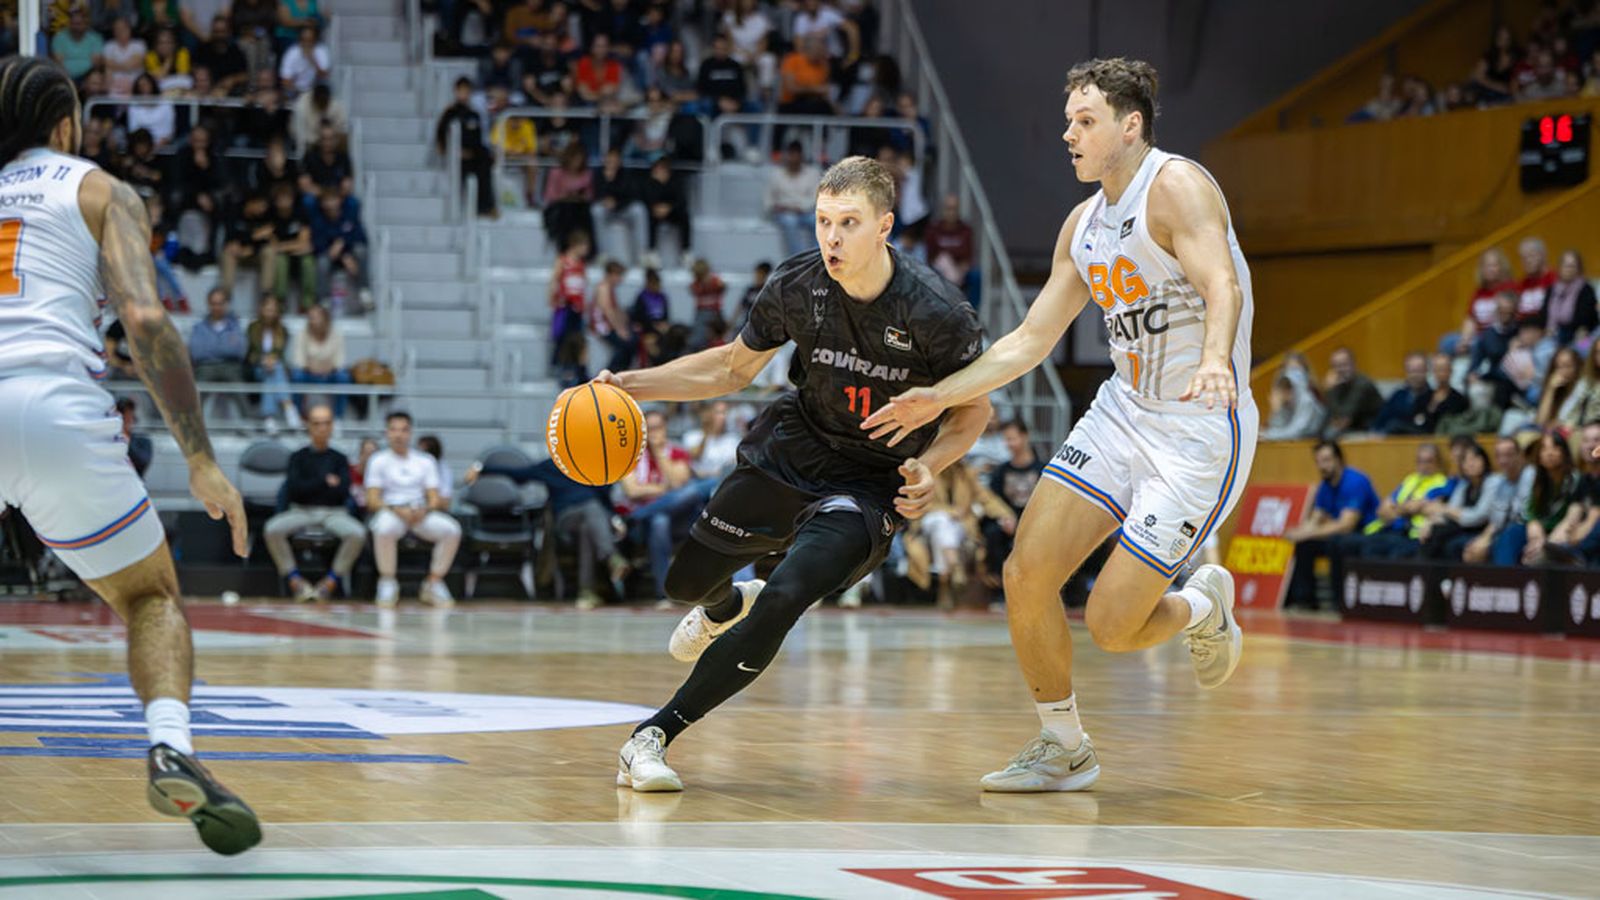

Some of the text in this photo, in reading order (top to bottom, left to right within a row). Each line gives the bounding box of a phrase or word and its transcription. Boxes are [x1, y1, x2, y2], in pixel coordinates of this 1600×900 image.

[0, 165, 48, 188] STON
[1088, 255, 1150, 311] BG
[844, 385, 871, 419] 11
[710, 516, 745, 537] asisa
